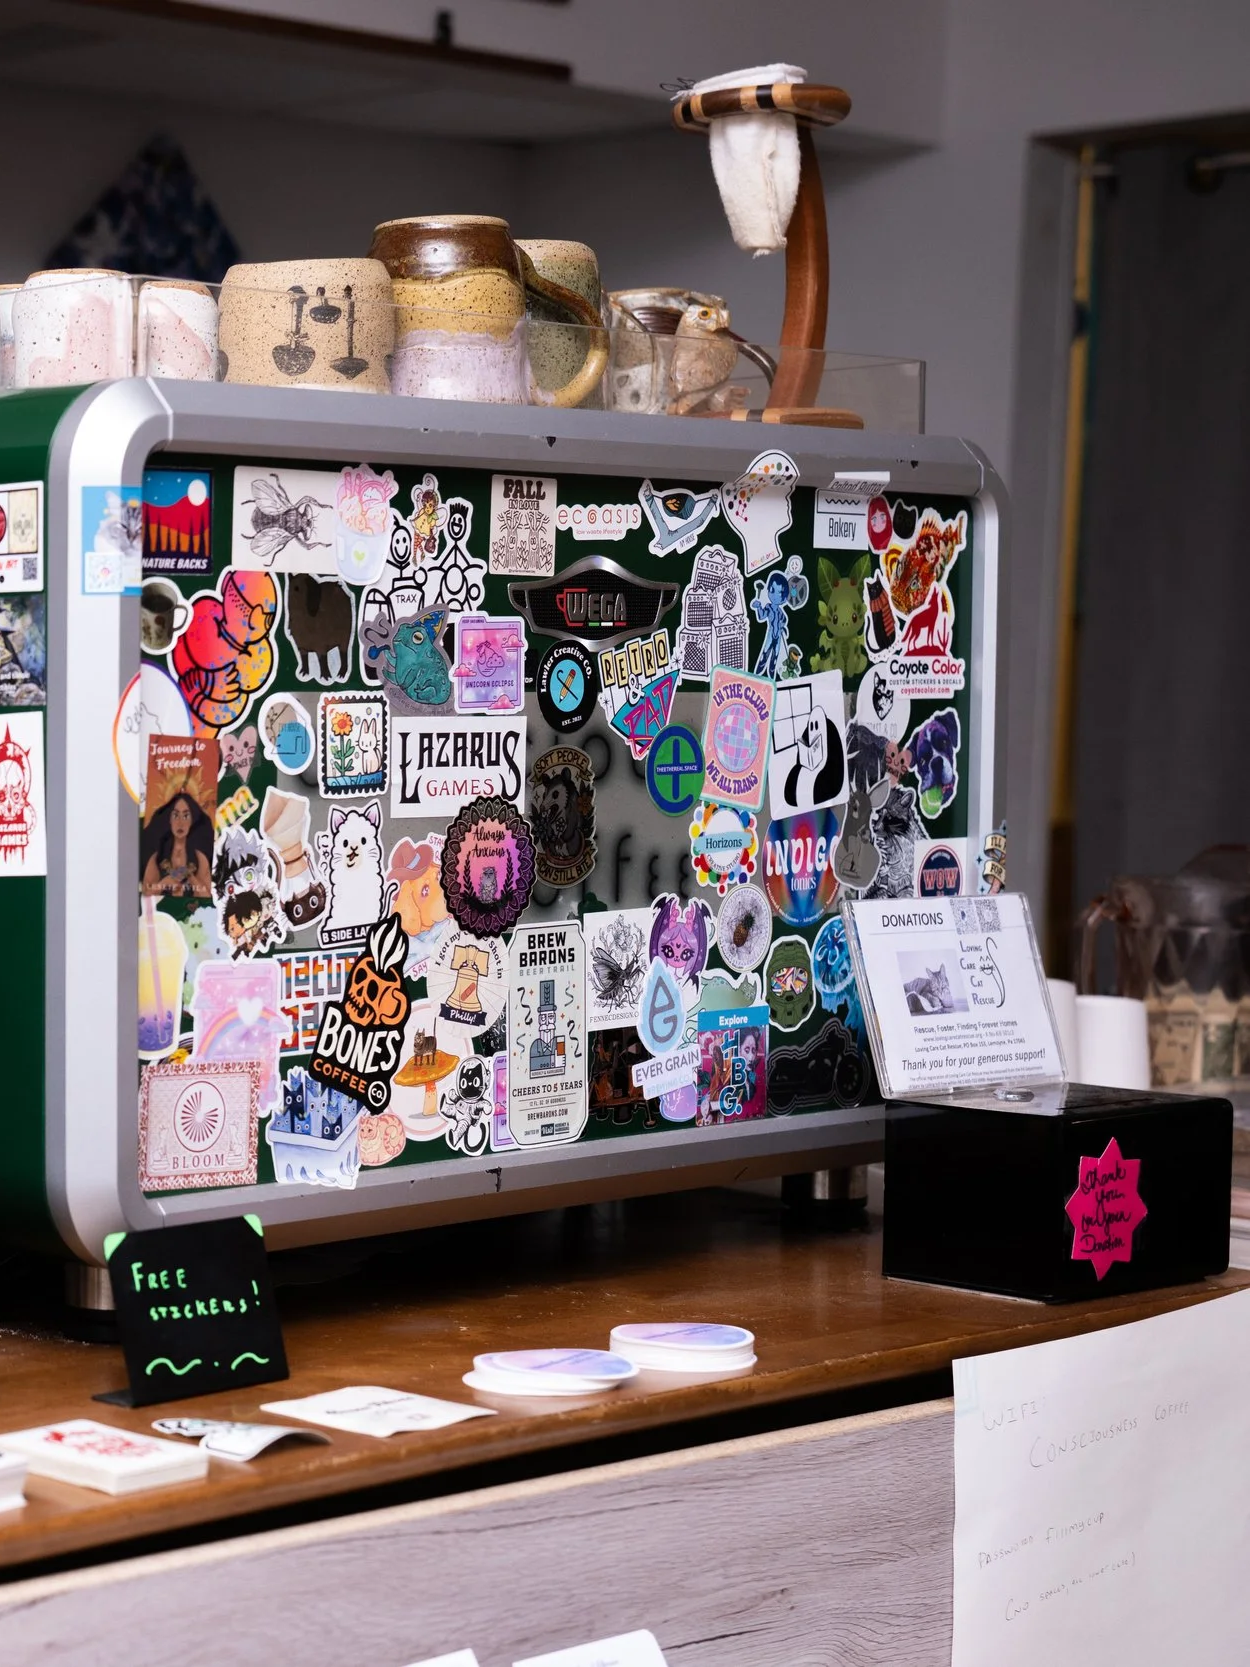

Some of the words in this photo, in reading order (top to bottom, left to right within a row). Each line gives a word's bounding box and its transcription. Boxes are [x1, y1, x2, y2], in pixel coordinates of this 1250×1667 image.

[503, 479, 546, 500] FALL
[509, 500, 518, 510] IN
[520, 500, 539, 510] LOVE
[142, 557, 176, 569] NATURE
[178, 558, 208, 570] BACKS
[395, 594, 417, 603] TRAX
[567, 593, 627, 621] WEGA
[540, 658, 554, 693] Lawler
[554, 647, 584, 661] Creative
[602, 637, 668, 686] RETRO
[890, 659, 928, 678] Coyote
[932, 659, 961, 674] Color
[628, 674, 644, 703] &
[713, 692, 725, 707] IN
[725, 683, 742, 699] THE
[901, 686, 950, 695] coyotecolor.com
[562, 719, 571, 727] EST.
[150, 742, 193, 756] Journey
[195, 741, 206, 751] to
[156, 759, 201, 770] Freedom
[398, 731, 521, 804] LAZARUS
[536, 752, 554, 773] SOFT
[557, 751, 587, 769] PEOPLE
[706, 760, 718, 779] WE
[717, 774, 732, 794] ALL
[733, 772, 759, 794] TRANS
[426, 779, 495, 797] GAMES
[472, 826, 506, 845] Always
[706, 838, 742, 848] Horizons
[472, 844, 506, 858] Anxious
[553, 869, 574, 881] STILL
[923, 867, 958, 890] WOW
[791, 877, 817, 891] tonics
[882, 912, 944, 927] DONATIONS
[322, 932, 330, 943] B
[331, 929, 353, 941] SIDE
[528, 931, 567, 949] BREW
[439, 941, 450, 961] got
[450, 931, 461, 944] my
[519, 948, 575, 967] BARONS
[412, 961, 428, 977] SAY
[497, 968, 505, 979] in
[519, 966, 544, 977] BEER
[547, 964, 575, 974] TRAIL
[450, 1009, 477, 1024] Philly!
[719, 1015, 748, 1026] Explore
[914, 1026, 937, 1034] Rescue,
[937, 1024, 956, 1032] Foster,
[957, 1023, 978, 1032] Finding
[317, 1006, 401, 1074] BONES
[636, 1062, 663, 1082] EVER
[665, 1052, 699, 1071] GRAIN
[902, 1059, 926, 1070] Thank
[929, 1059, 944, 1070] you
[945, 1055, 956, 1067] for
[958, 1055, 976, 1069] your
[977, 1053, 1013, 1066] generous
[1014, 1048, 1046, 1063] support!
[313, 1059, 367, 1094] COFFEE
[371, 1087, 384, 1100] CO.
[512, 1086, 540, 1097] CHEERS
[542, 1085, 552, 1093] TO
[553, 1083, 558, 1092] 5
[560, 1080, 583, 1090] YEARS
[172, 1154, 225, 1169] BLOOM
[131, 1262, 187, 1292] FREE
